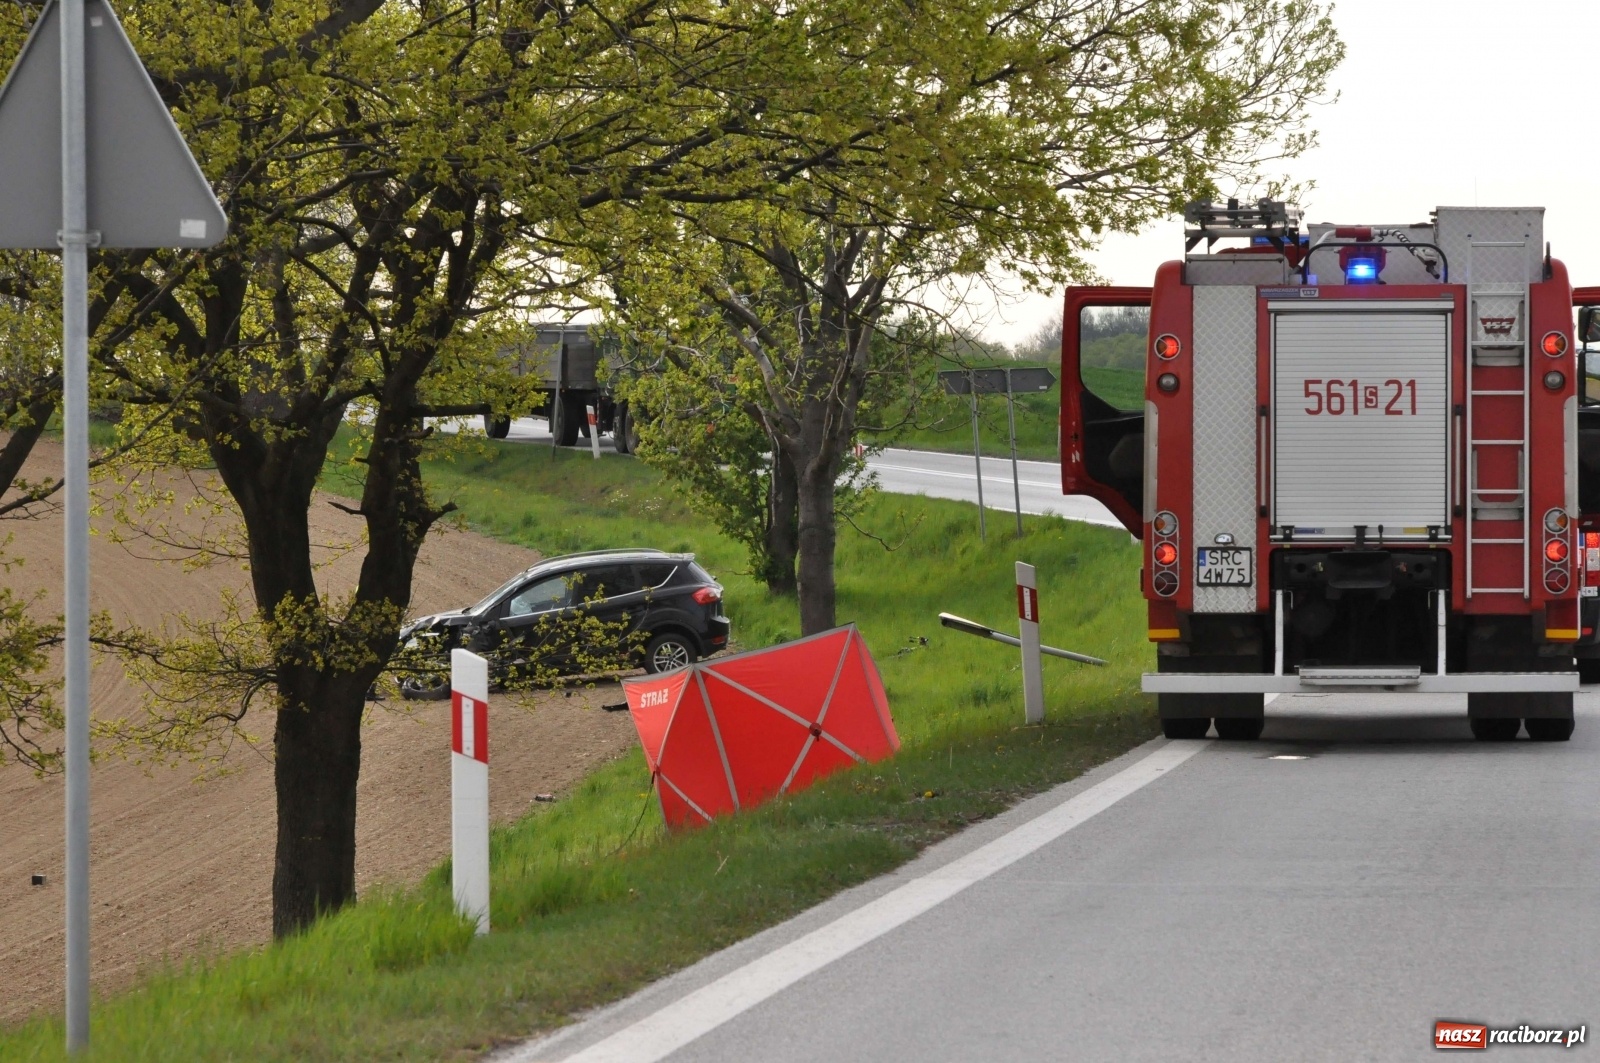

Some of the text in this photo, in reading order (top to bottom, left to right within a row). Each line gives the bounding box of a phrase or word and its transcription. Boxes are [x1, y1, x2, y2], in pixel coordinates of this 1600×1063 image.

[1304, 379, 1417, 416] 561 S 21
[1209, 550, 1242, 566] SRC
[1203, 568, 1246, 584] 4W75
